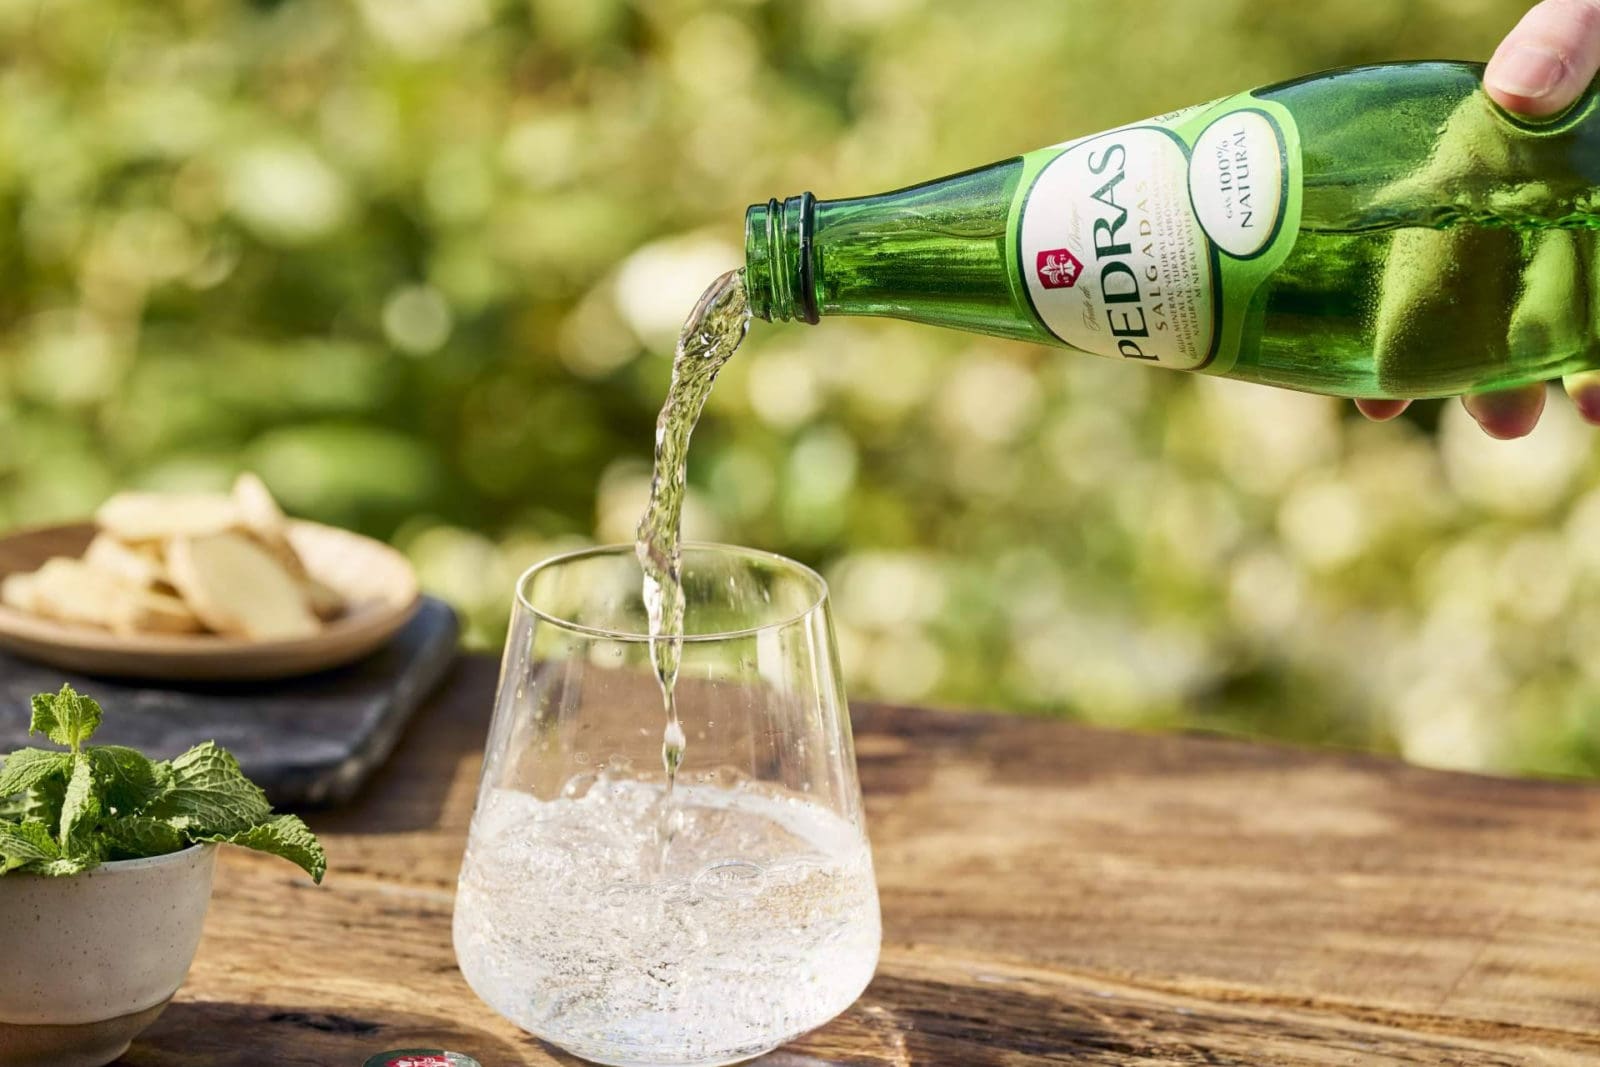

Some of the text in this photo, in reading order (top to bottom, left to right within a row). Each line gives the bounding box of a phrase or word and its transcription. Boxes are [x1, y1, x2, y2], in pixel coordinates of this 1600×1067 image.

[1216, 140, 1233, 192] 100%
[1233, 127, 1253, 228] NATURAL
[1088, 144, 1160, 361] PEDRAS
[1136, 181, 1168, 331] SALGADAS
[1177, 219, 1190, 279] SPARKLING
